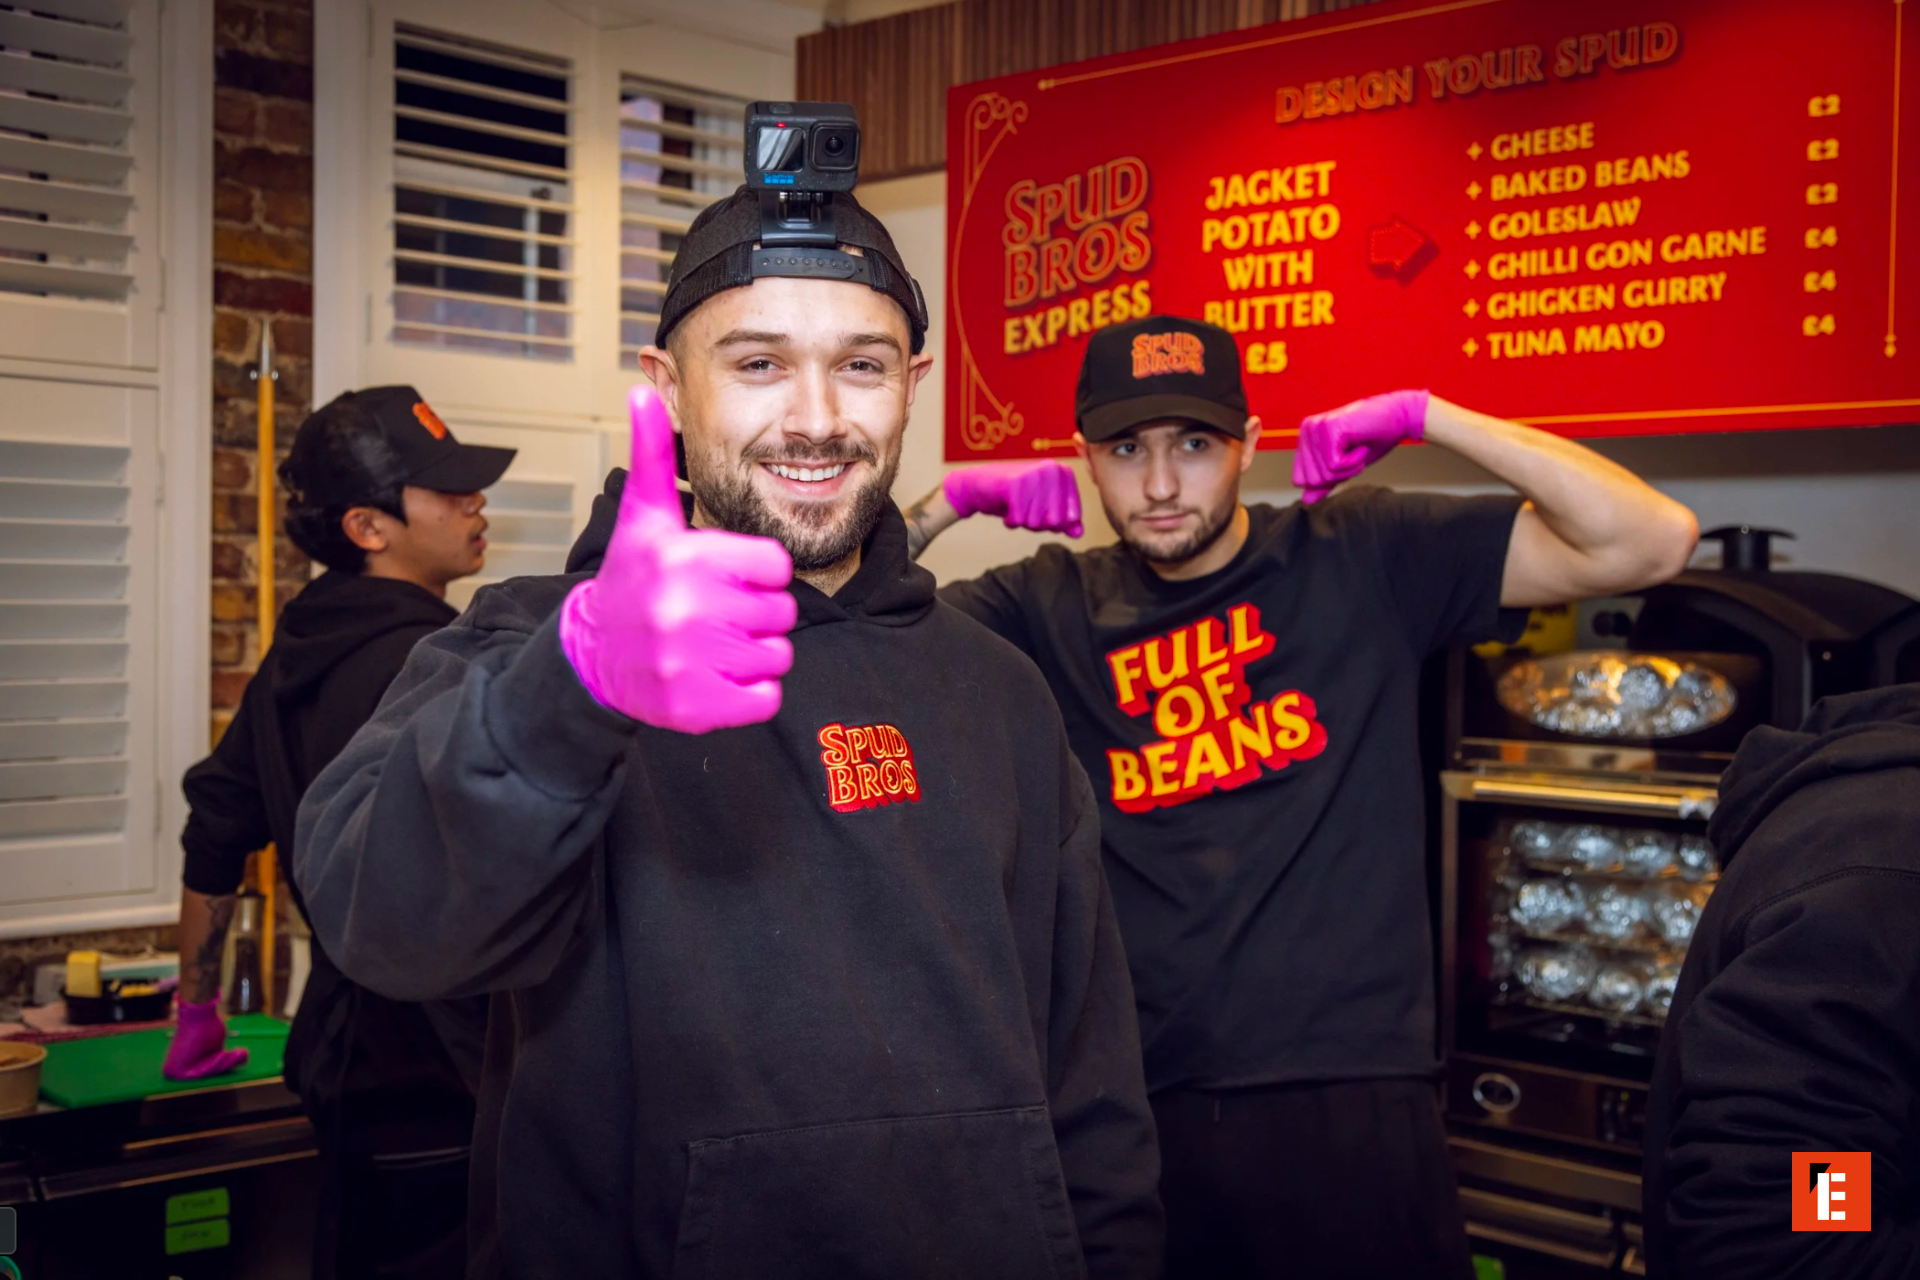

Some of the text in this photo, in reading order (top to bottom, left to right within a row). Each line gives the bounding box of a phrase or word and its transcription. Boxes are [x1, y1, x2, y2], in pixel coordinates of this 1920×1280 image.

[1275, 22, 1679, 123] DESIGN YOUR SPUD
[1491, 122, 1594, 160] CHEESE
[1206, 161, 1336, 210] JACKET
[1490, 165, 1587, 201] BAKED
[1595, 151, 1690, 187] BEANS
[1003, 157, 1148, 248] SPUD
[1488, 197, 1641, 241] COLESLAW
[1202, 205, 1340, 253] POTATO
[1804, 226, 1838, 249] £4
[1004, 212, 1151, 307] BROS
[1223, 250, 1313, 290] WITH
[1487, 246, 1578, 280] CHILLI
[1586, 238, 1653, 271] CON
[1660, 227, 1766, 263] CARNE
[1487, 284, 1614, 320] CHICKEN
[1622, 273, 1727, 308] CURRY
[1803, 270, 1837, 292] £4
[1004, 281, 1151, 354] EXPRESS
[1204, 291, 1335, 334] BUTTER
[1802, 314, 1836, 336] £4
[1132, 332, 1204, 357] SPUD
[1246, 342, 1287, 374] £5
[1487, 328, 1567, 359] TUNA
[1574, 320, 1665, 353] MAYO
[1132, 352, 1205, 378] BROS
[1108, 604, 1269, 706] FULL
[1155, 661, 1236, 738] OF
[819, 724, 908, 767] SPUD
[1108, 693, 1312, 801] BEANS
[827, 760, 917, 805] BROS
